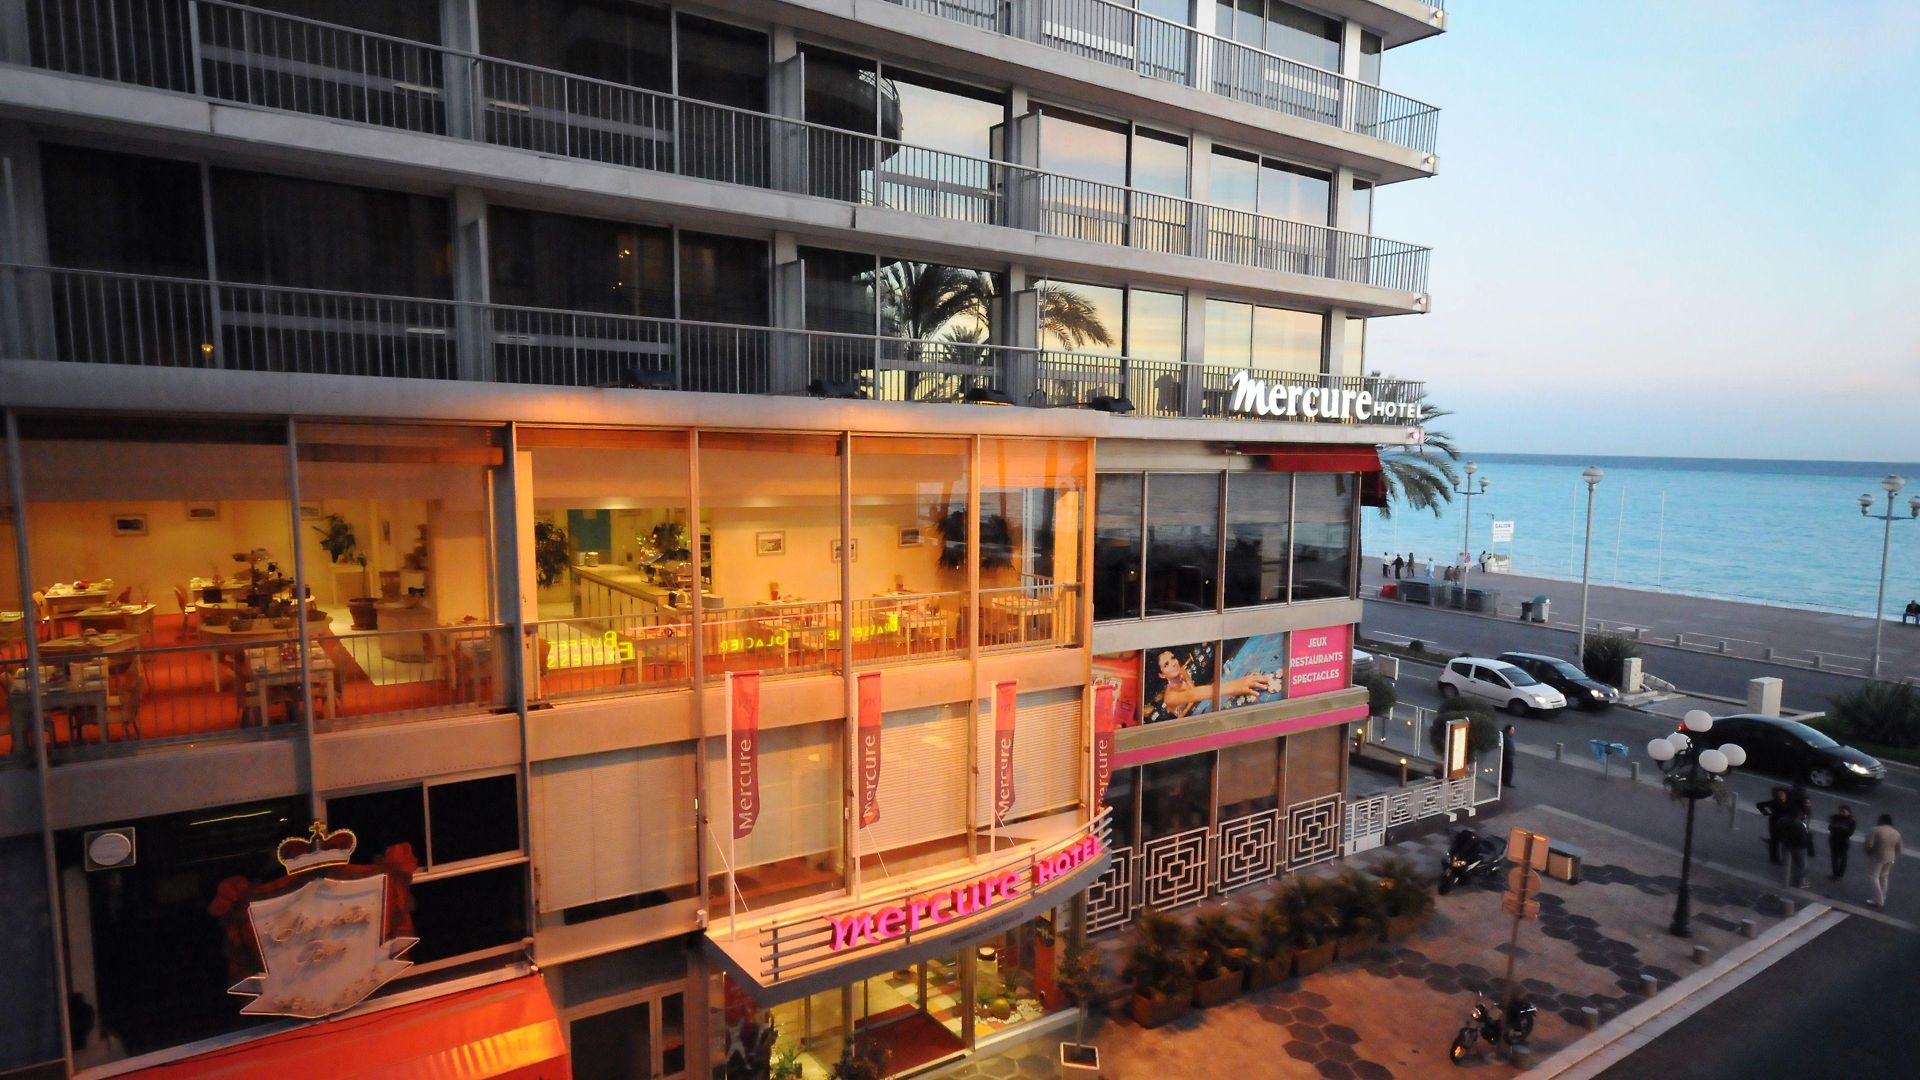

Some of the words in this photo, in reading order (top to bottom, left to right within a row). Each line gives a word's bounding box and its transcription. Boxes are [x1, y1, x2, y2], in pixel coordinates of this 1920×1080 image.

[1230, 369, 1372, 420] Mercure
[1373, 400, 1423, 419] HOTEL
[1290, 651, 1343, 668] RESTAURANTS
[1308, 636, 1327, 648] JEUX
[1292, 669, 1340, 685] SPECTACLES
[738, 738, 752, 830] Mercure
[998, 737, 1012, 816] Mercure
[1032, 833, 1104, 885] HOTEL
